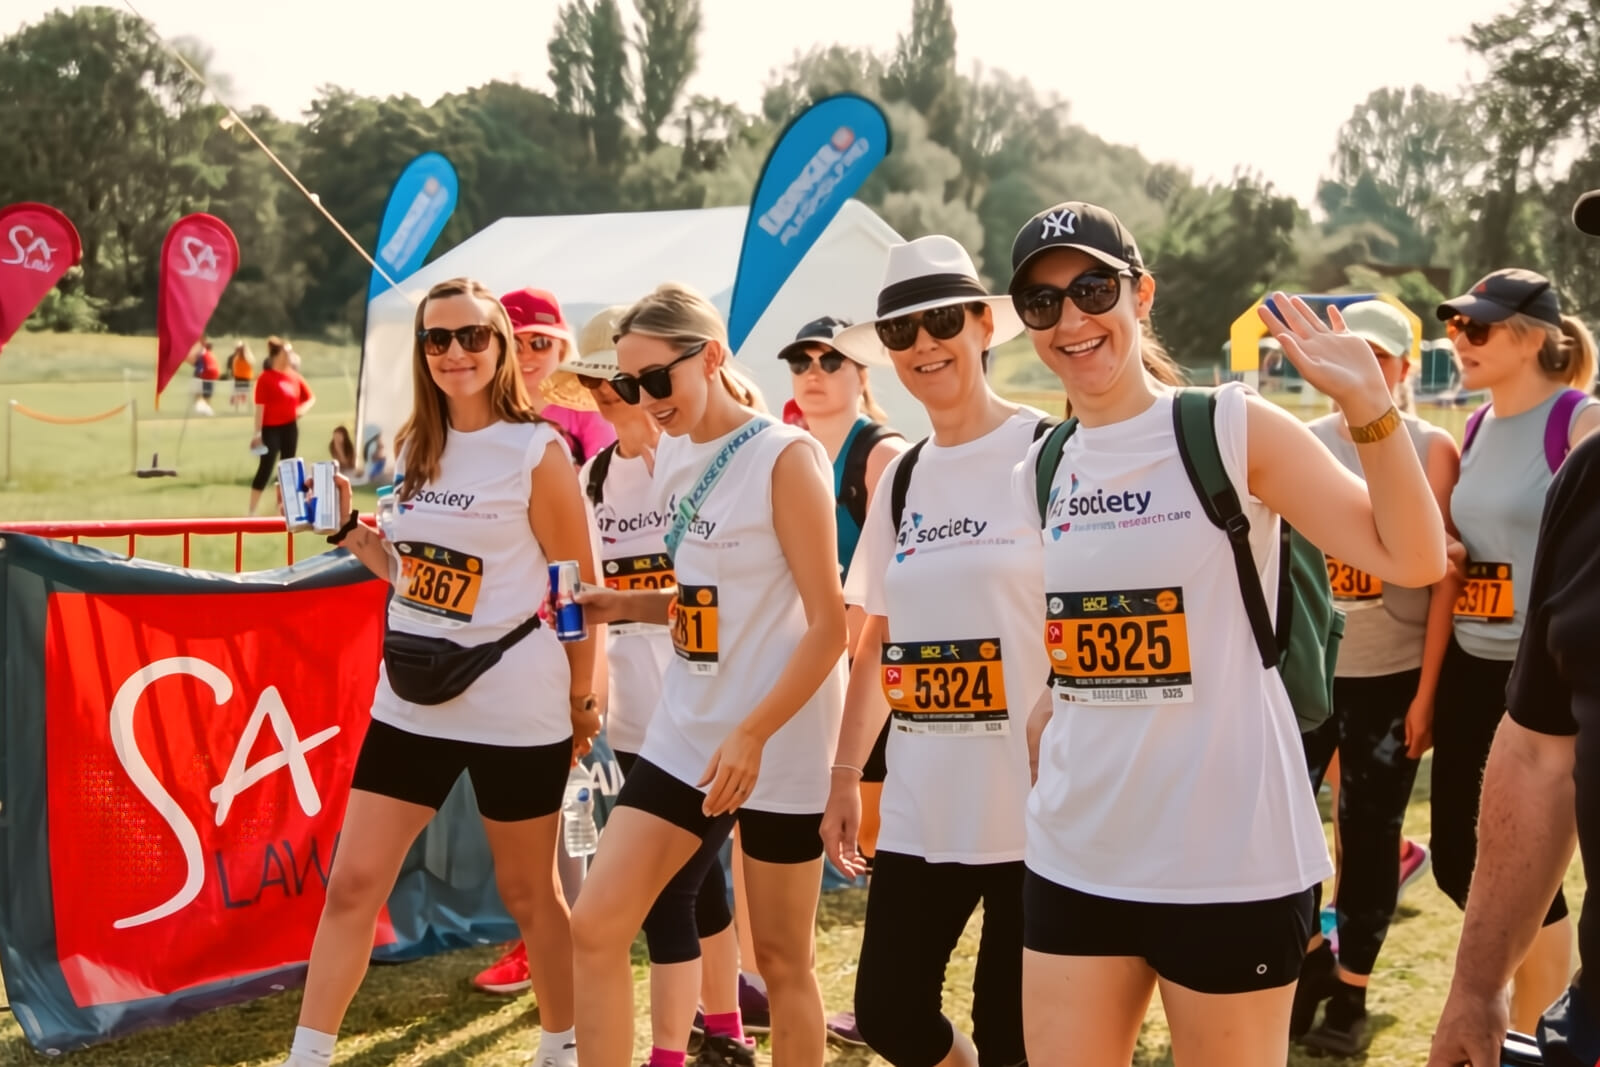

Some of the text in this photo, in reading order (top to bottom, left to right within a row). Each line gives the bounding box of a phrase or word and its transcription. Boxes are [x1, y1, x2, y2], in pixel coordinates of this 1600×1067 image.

[1, 225, 58, 265] SA
[179, 236, 221, 276] SA
[415, 489, 475, 511] society
[1069, 488, 1151, 515] society
[1118, 514, 1165, 529] research
[1167, 510, 1191, 521] care
[916, 517, 987, 543] society
[1077, 619, 1172, 673] 5325
[914, 665, 993, 709] 5324
[110, 656, 341, 929] SA
[215, 832, 341, 909] LAW
